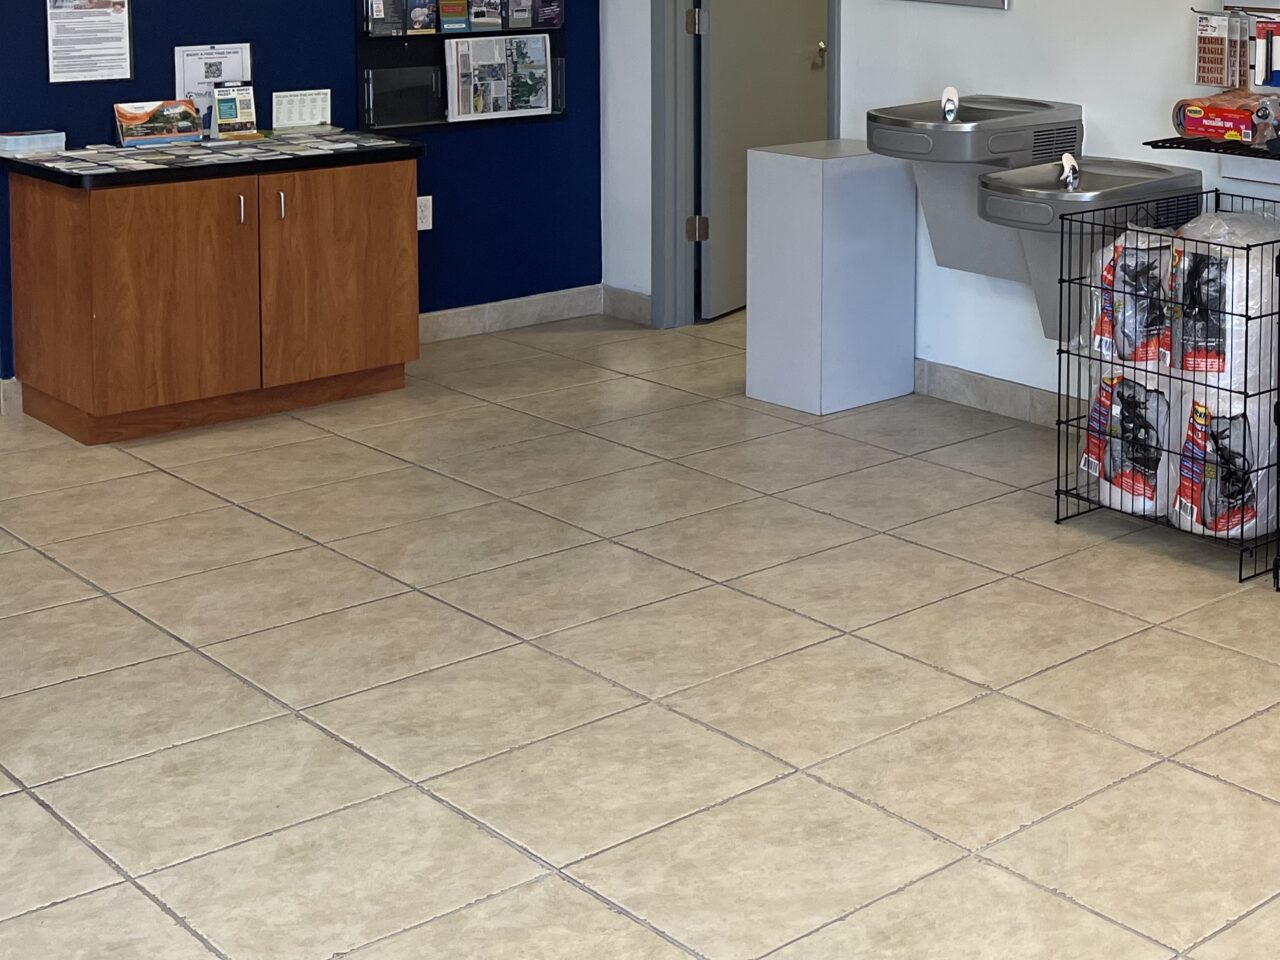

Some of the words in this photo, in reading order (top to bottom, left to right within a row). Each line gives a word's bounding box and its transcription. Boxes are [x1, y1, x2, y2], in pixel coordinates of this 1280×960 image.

[1199, 37, 1224, 46] FRAGILE
[1199, 46, 1224, 56] FRAGILE
[1199, 56, 1224, 65] FRAGILE
[1198, 66, 1223, 75] FRAGILE
[1198, 75, 1223, 84] FRAGILE
